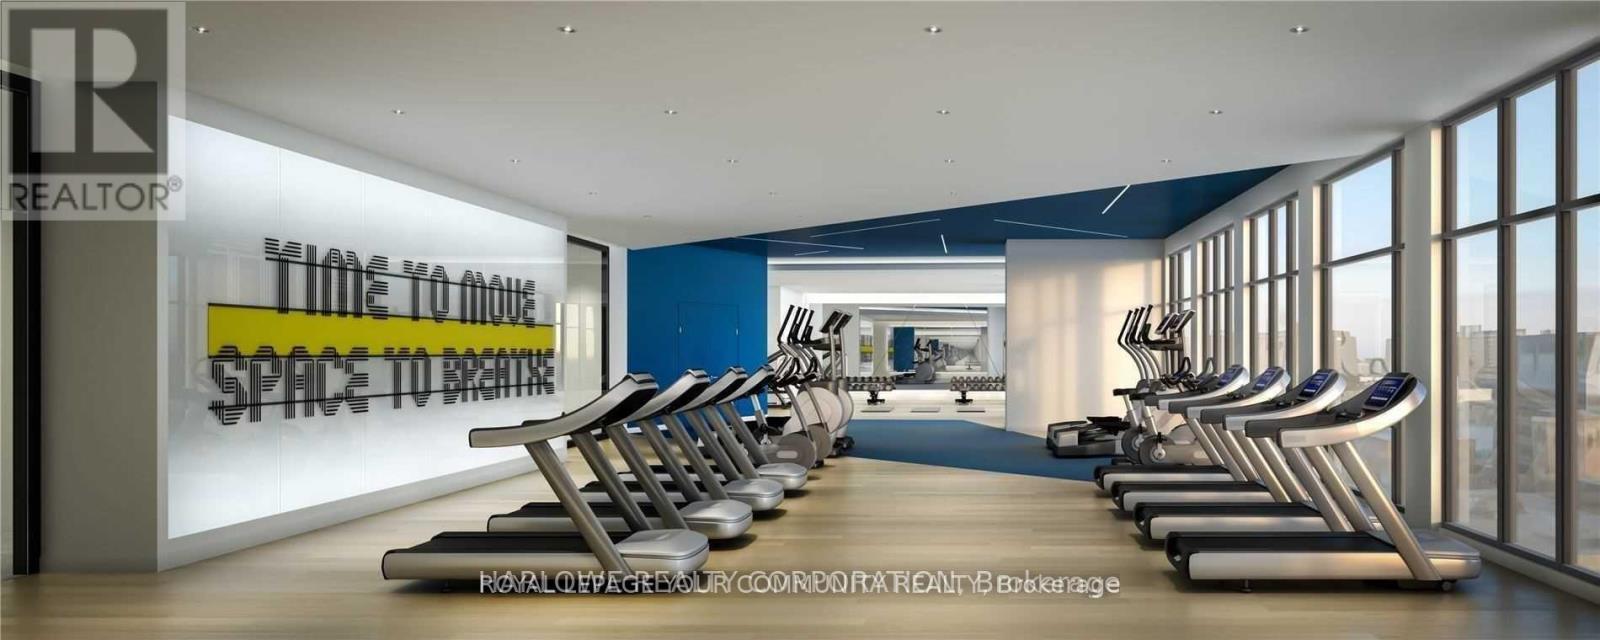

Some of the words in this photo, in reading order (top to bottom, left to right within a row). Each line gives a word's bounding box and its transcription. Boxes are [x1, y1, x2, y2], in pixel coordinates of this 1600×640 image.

[264, 237, 389, 320] TIME
[403, 259, 450, 323] TO
[460, 269, 536, 329] MOVE
[210, 344, 369, 426] SPACE
[384, 346, 432, 409] TO
[443, 347, 556, 405] BREATHE
